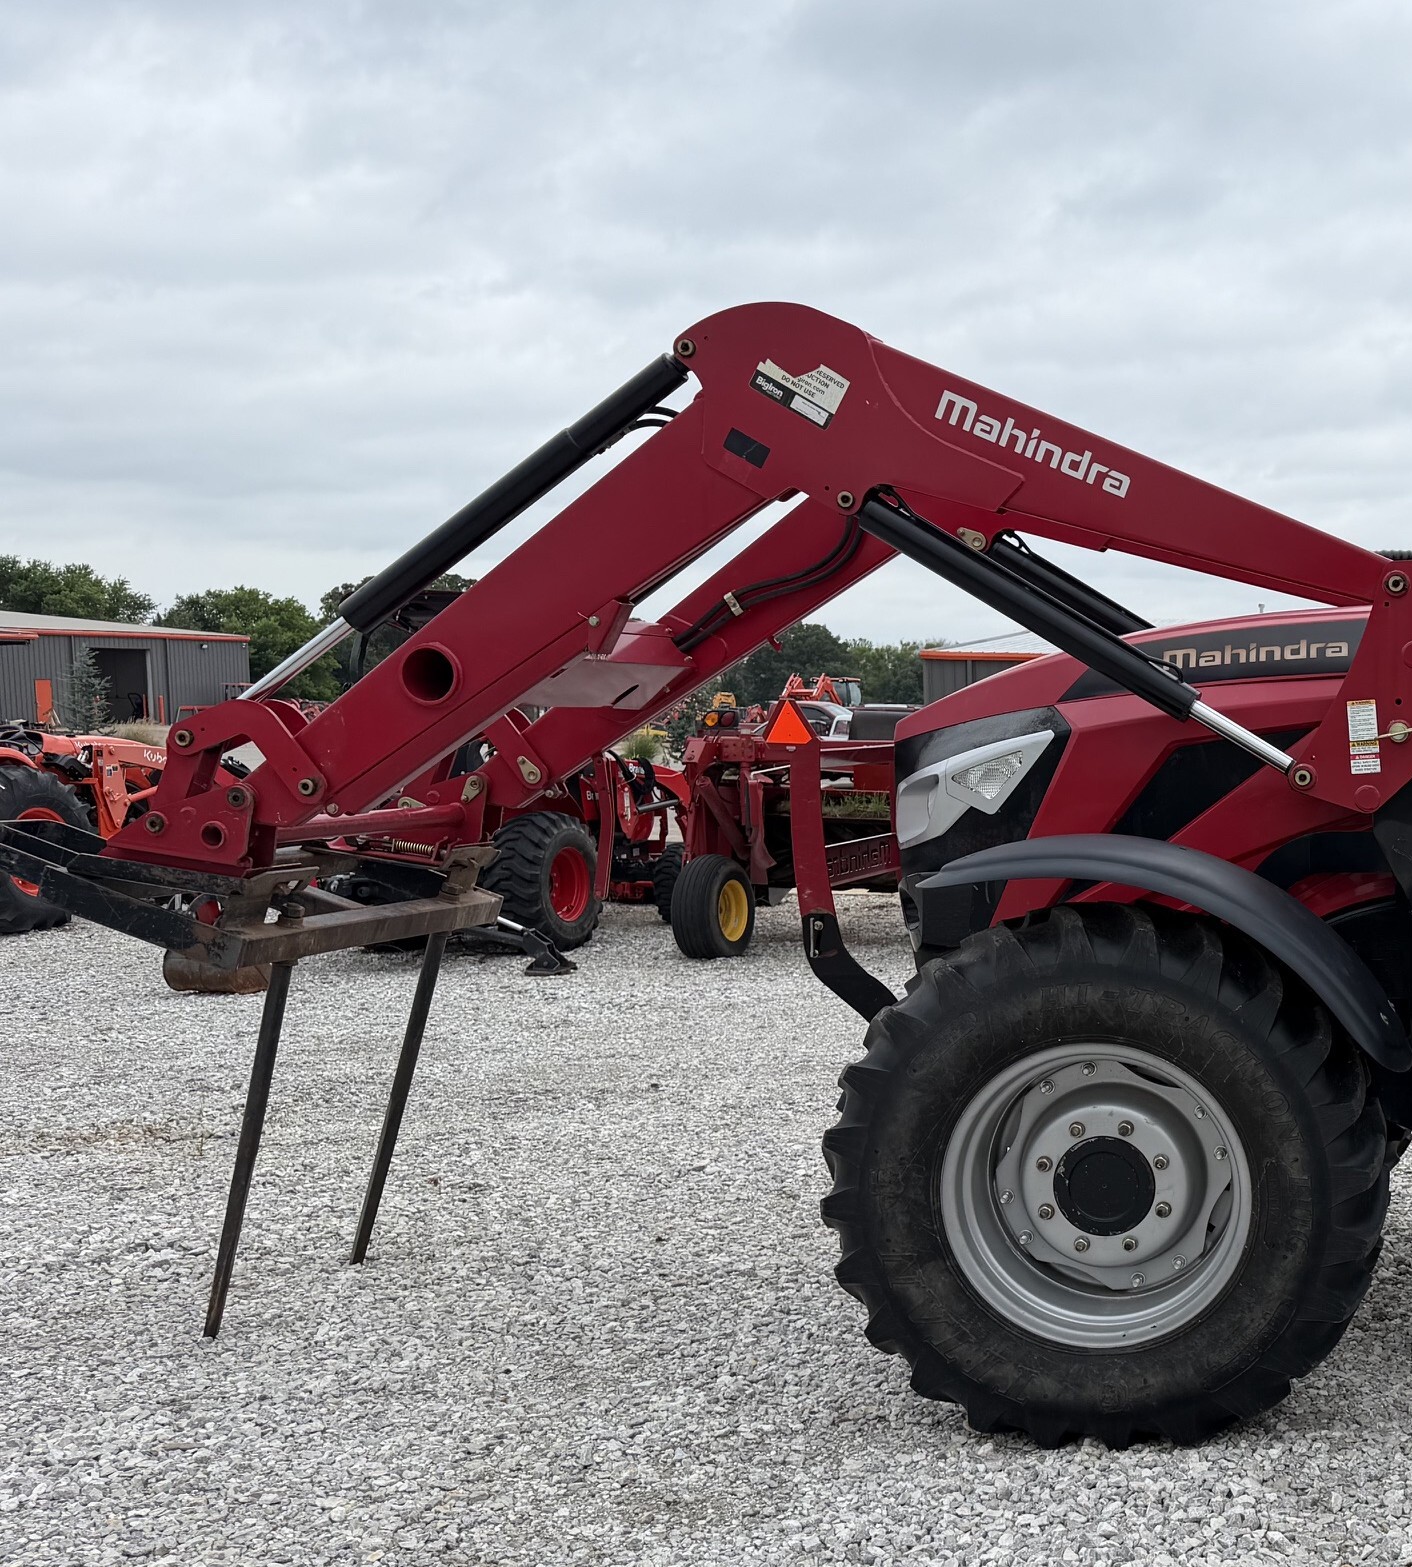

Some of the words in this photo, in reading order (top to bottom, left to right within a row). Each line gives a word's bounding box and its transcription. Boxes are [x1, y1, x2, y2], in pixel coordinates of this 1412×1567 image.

[755, 376, 783, 397] BigIron
[781, 375, 790, 383] DO
[791, 379, 804, 390] NOT
[804, 388, 816, 398] USE
[806, 373, 830, 389] UCTION
[934, 389, 1131, 499] Mahindra
[1162, 639, 1349, 670] Mahindra
